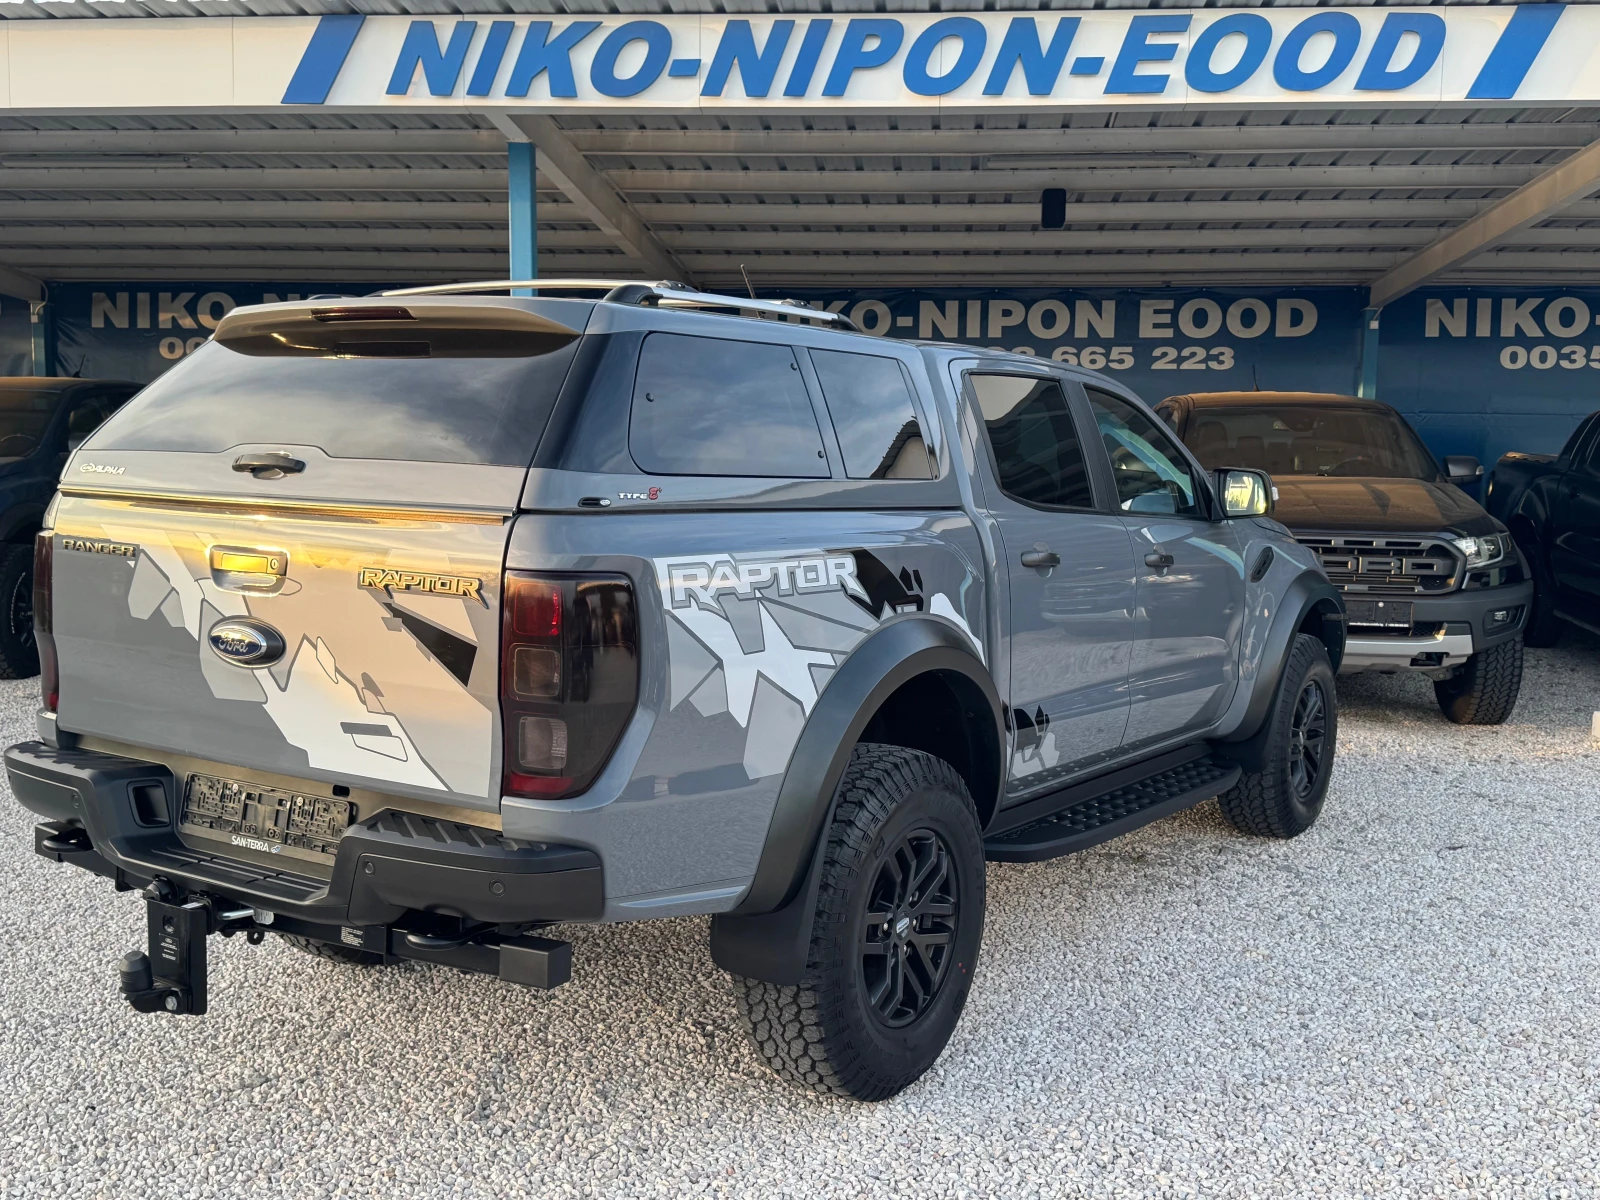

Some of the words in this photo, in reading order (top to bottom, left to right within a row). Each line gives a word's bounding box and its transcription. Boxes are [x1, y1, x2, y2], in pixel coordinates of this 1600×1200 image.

[385, 11, 1447, 98] NIKO-NIPON-EOOD
[91, 291, 308, 330] NIKO
[1138, 298, 1319, 339] EOOD
[1051, 346, 1135, 371] 665
[1151, 346, 1236, 371] 223
[618, 492, 648, 501] TYPE
[63, 539, 137, 558] RANGER
[360, 567, 489, 610] RAPTOR
[668, 554, 873, 613] RAPTOR
[218, 633, 249, 653] Ford
